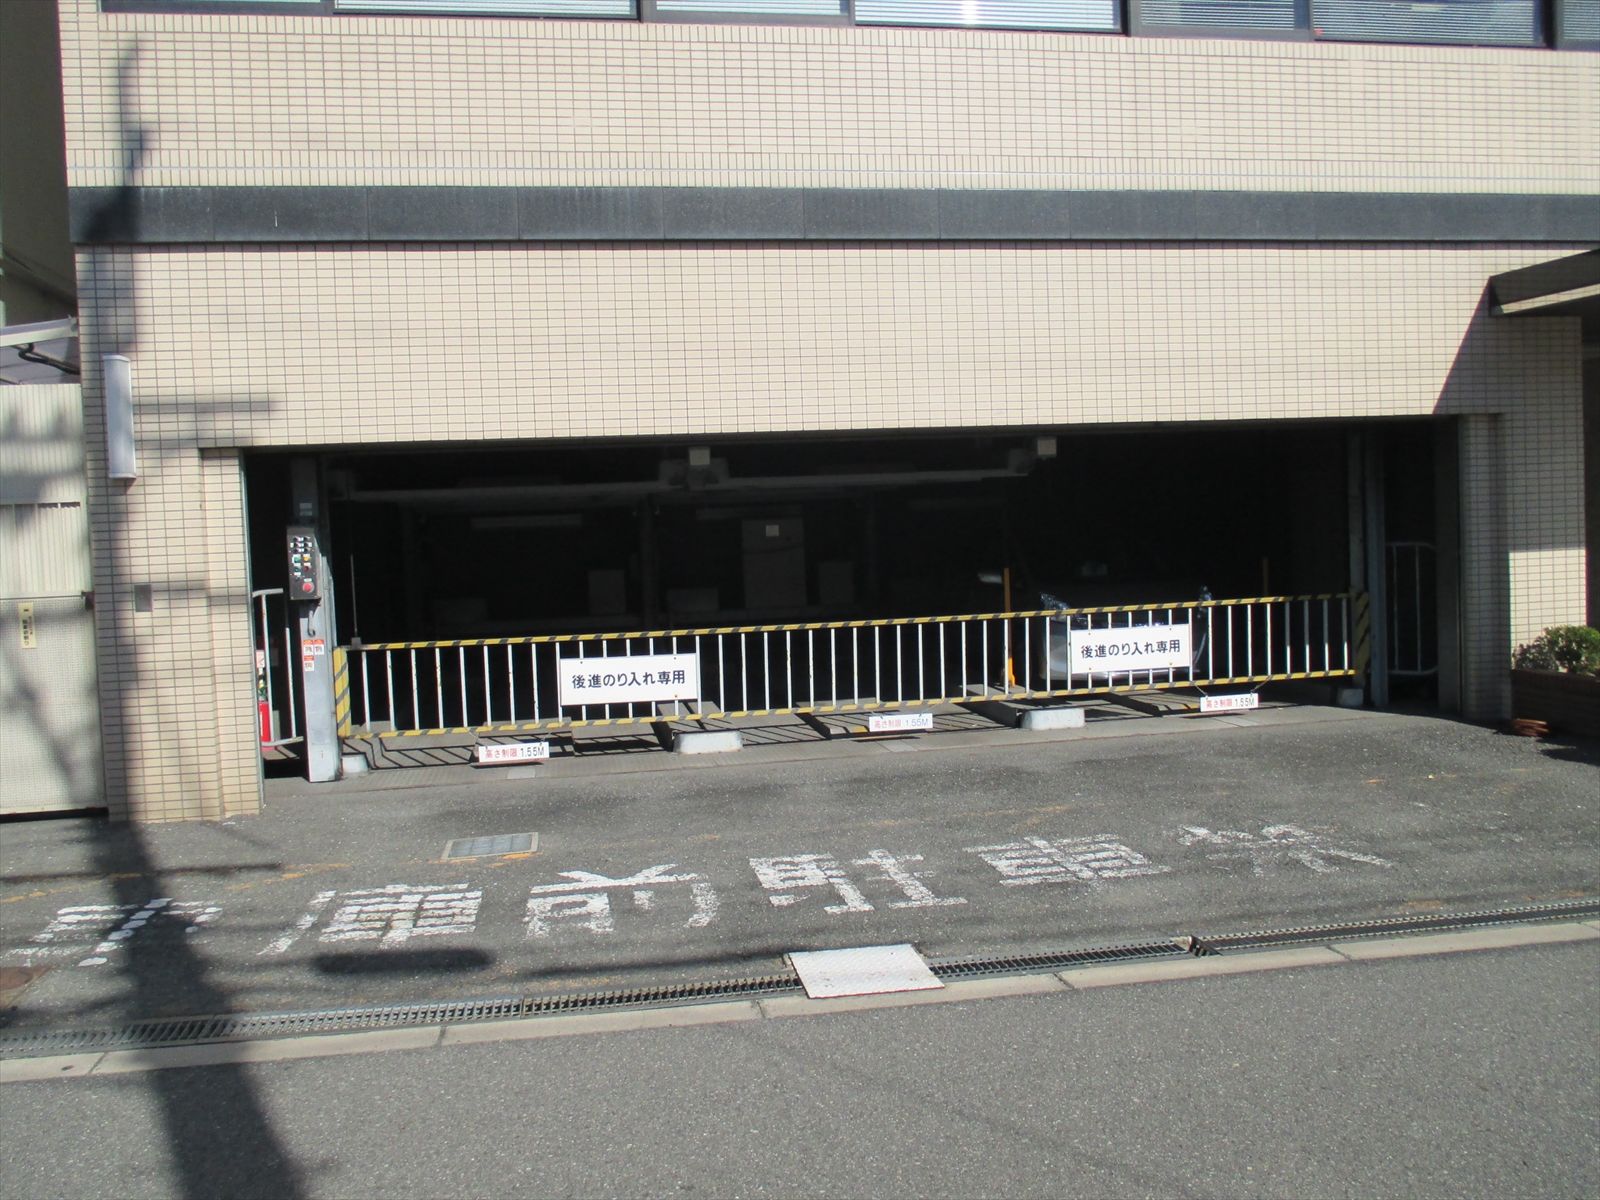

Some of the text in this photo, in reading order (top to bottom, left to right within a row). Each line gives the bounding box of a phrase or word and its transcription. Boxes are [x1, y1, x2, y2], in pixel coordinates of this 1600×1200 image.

[1081, 639, 1181, 658] 後進のり入れ専用
[572, 670, 685, 689] 後進のり入れ専用
[485, 746, 544, 759] 高さ制限 1.55M
